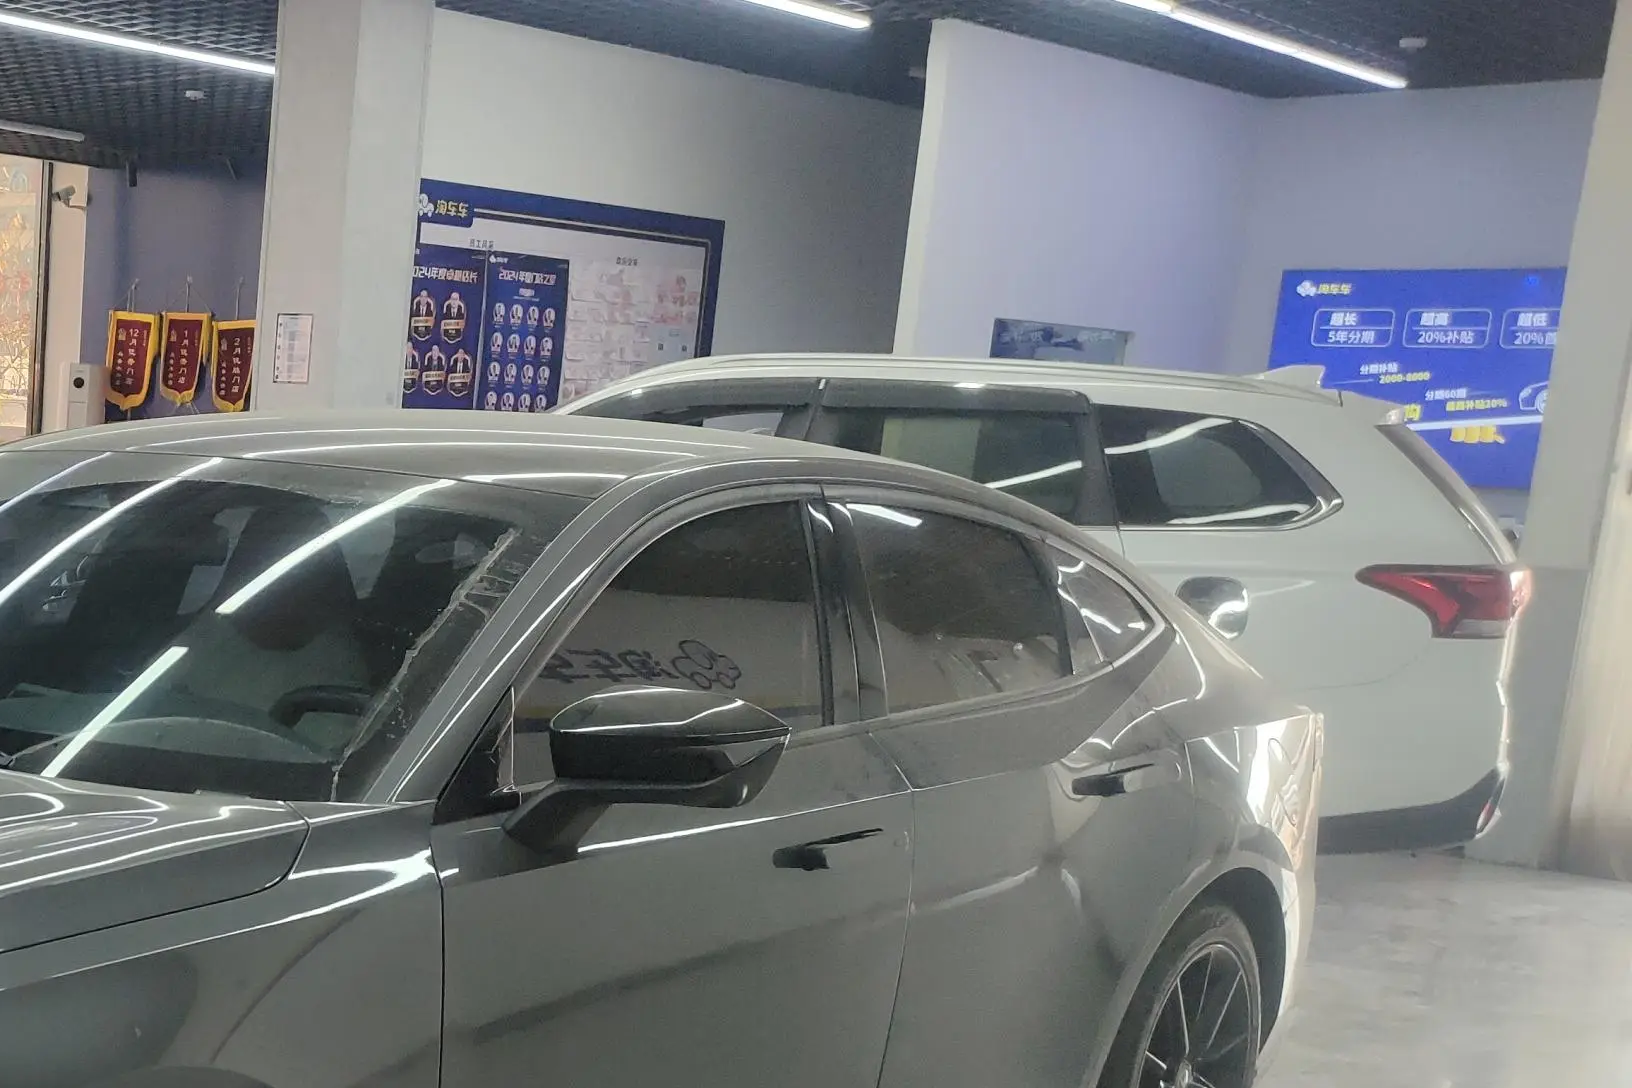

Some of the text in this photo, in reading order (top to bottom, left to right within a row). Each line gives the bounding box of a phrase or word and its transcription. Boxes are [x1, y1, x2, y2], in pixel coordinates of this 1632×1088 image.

[435, 199, 469, 218] 淘车车
[1327, 330, 1376, 344] 5年分期
[1418, 330, 1475, 345] 20%补贴
